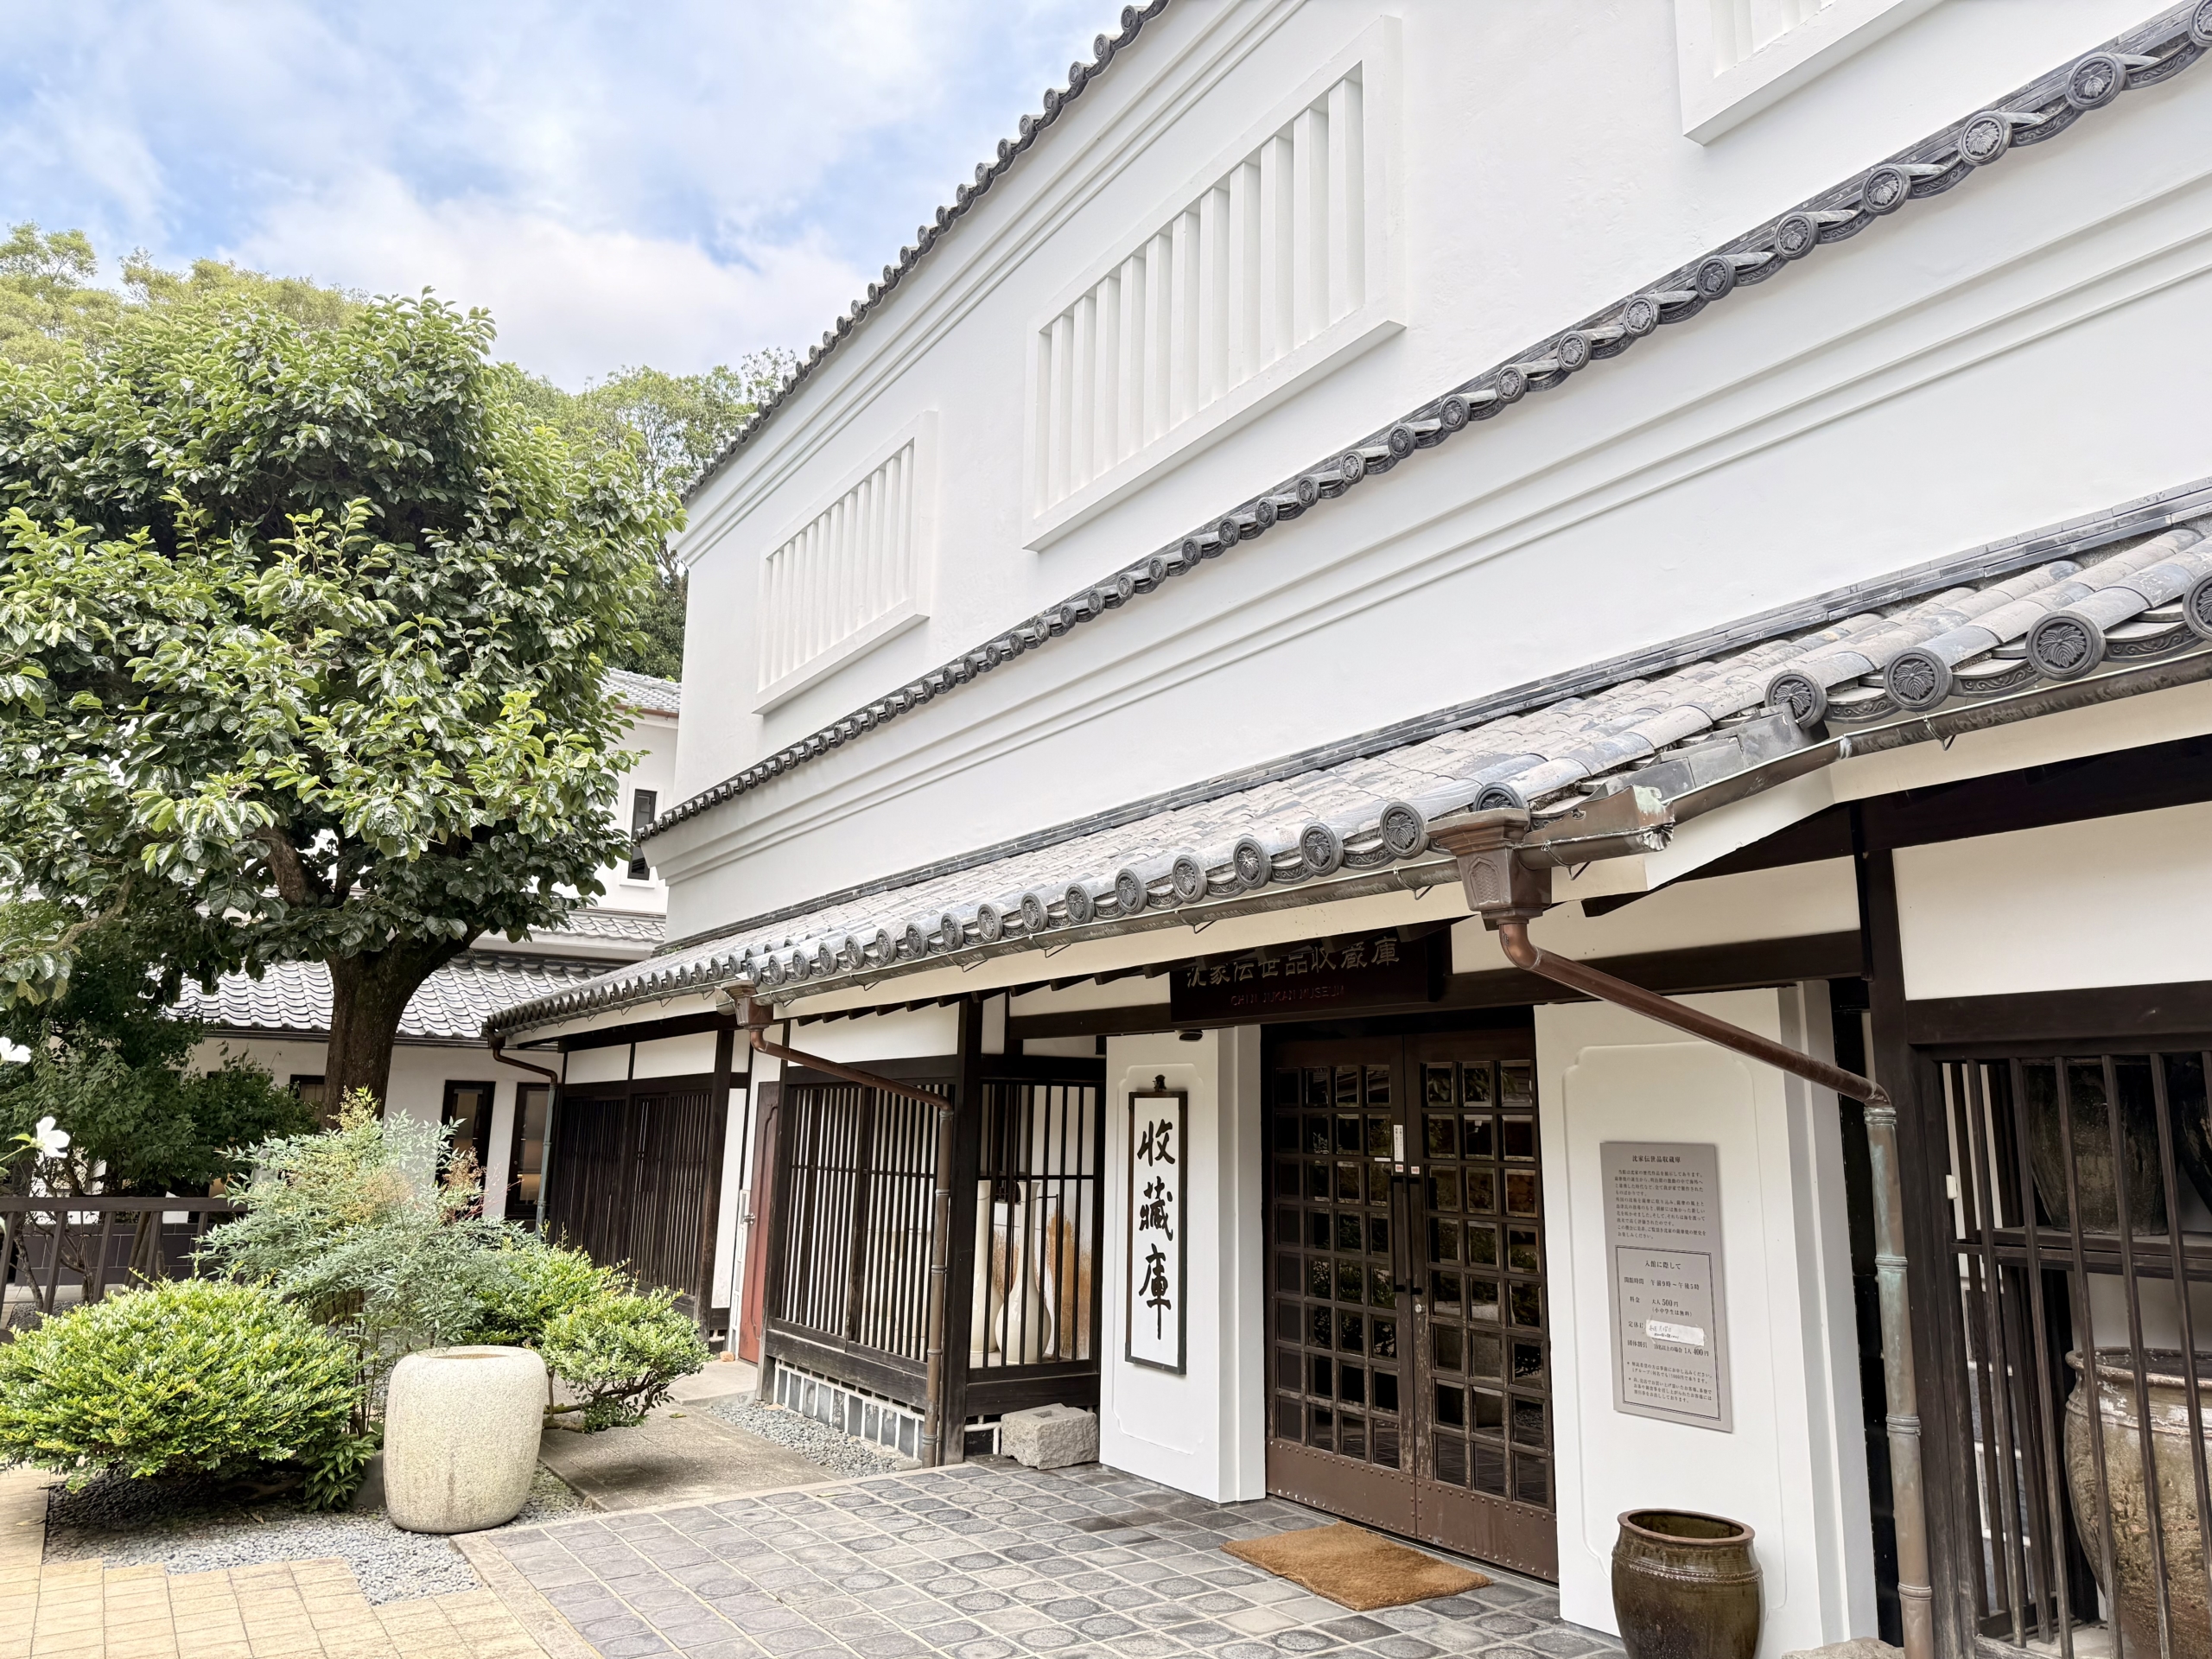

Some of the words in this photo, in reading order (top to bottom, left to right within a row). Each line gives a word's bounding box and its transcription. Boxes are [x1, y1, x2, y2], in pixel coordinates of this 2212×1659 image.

[1230, 994, 1257, 1007] CHIN
[1262, 989, 1296, 1004] JUKAN
[1300, 984, 1345, 1000] MUSEUM
